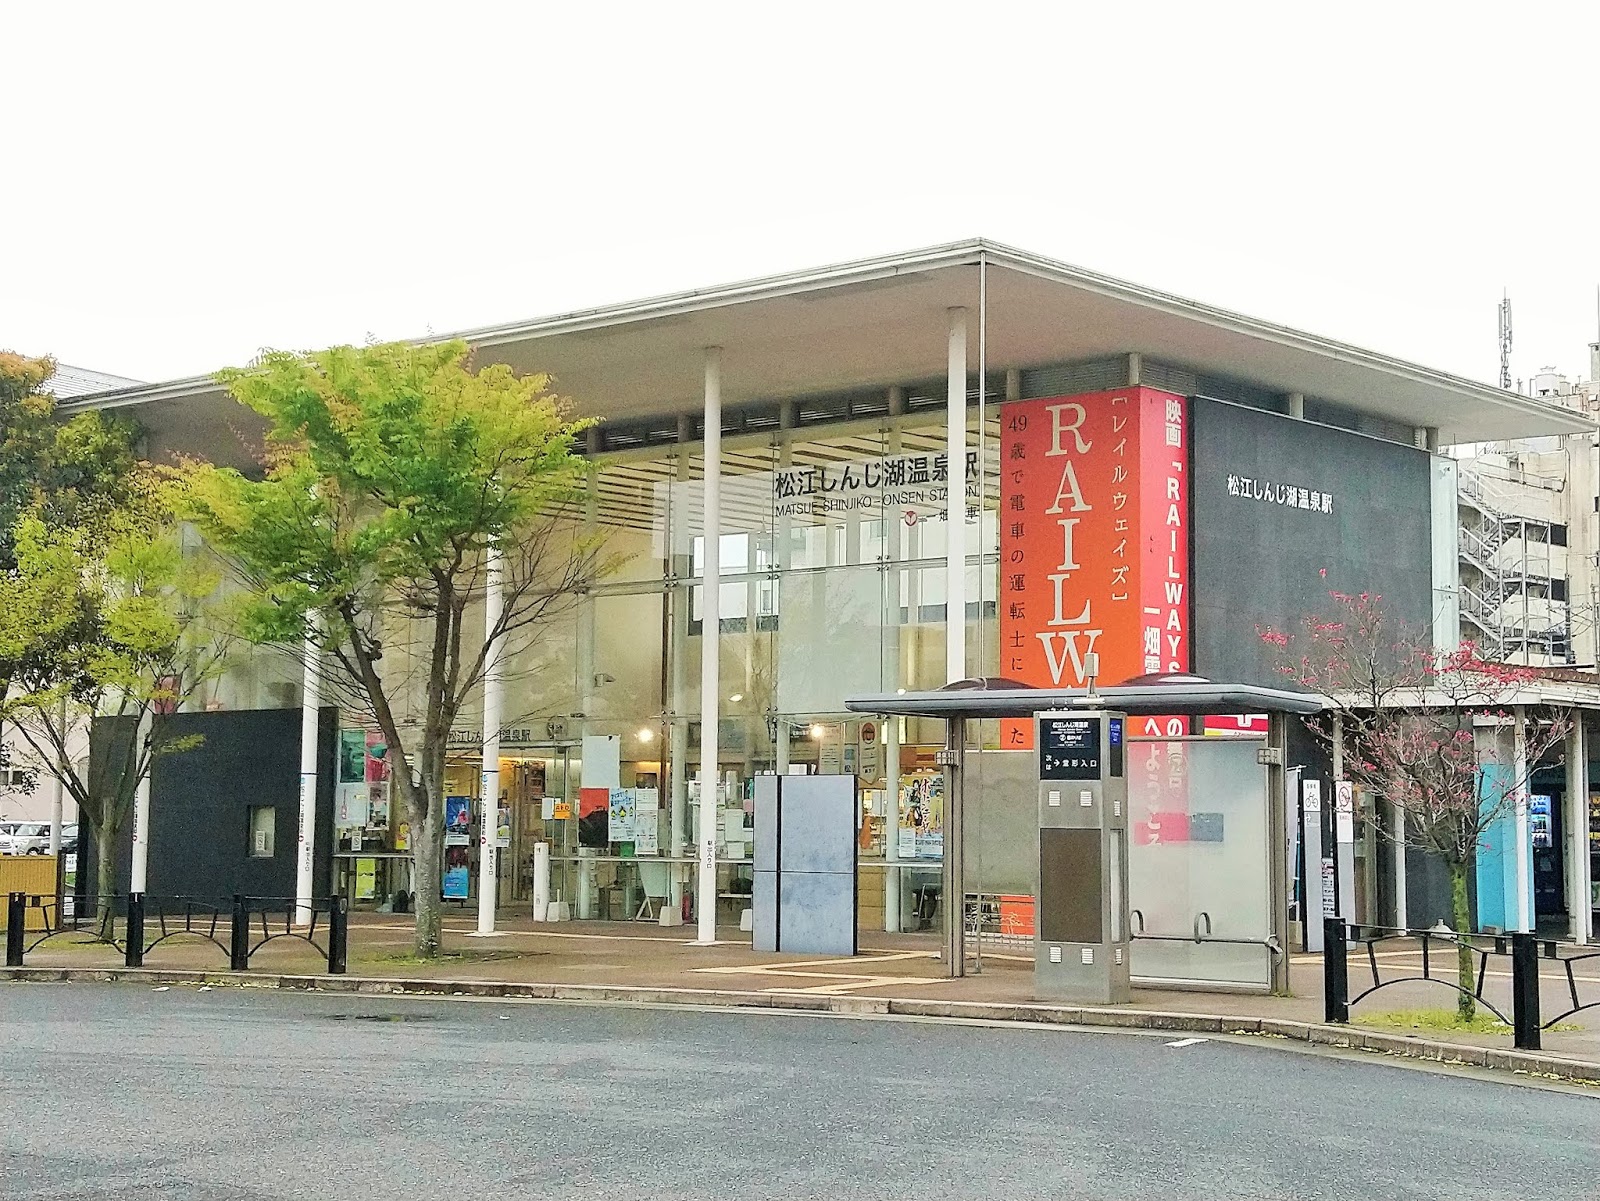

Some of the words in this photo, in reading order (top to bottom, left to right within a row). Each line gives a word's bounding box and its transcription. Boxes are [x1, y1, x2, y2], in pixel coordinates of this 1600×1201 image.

[775, 501, 818, 518] MATSUE
[929, 485, 978, 502] STAN
[1227, 473, 1333, 515] 松江しんじ湖温泉駅
[926, 507, 980, 524] 一畑車
